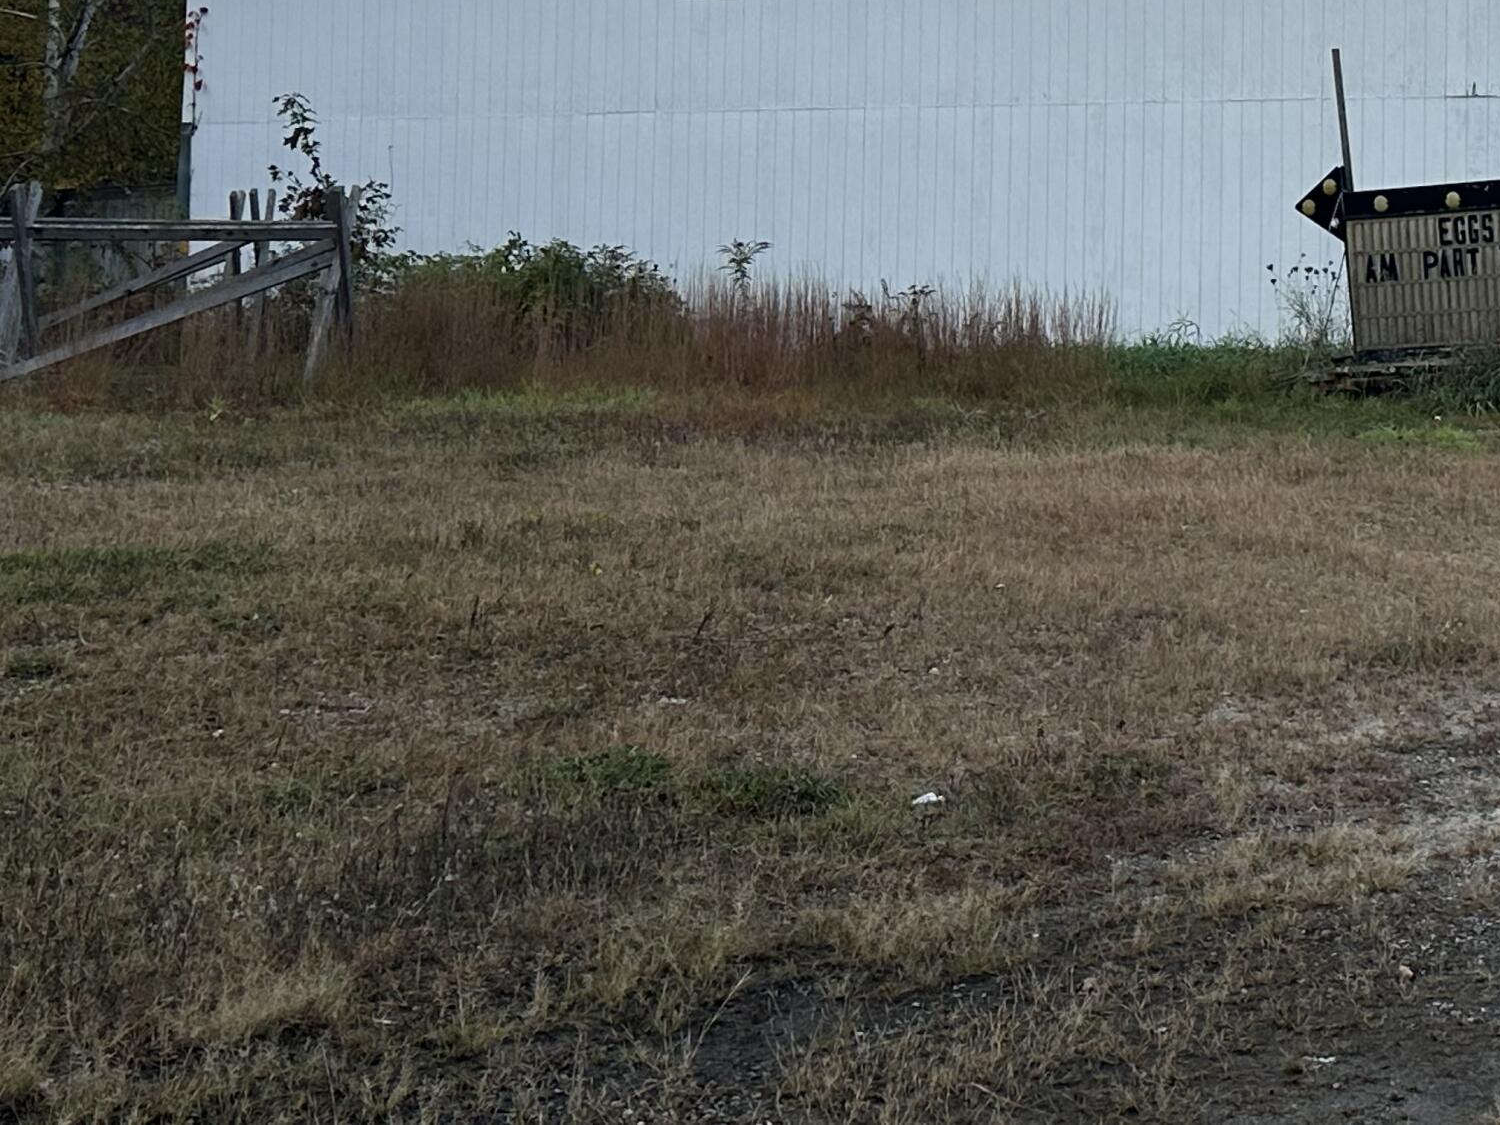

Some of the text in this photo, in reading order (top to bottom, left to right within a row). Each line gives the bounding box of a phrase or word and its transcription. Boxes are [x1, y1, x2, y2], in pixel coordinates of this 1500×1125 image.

[1439, 214, 1494, 246] EGGS
[1366, 253, 1398, 283] AM
[1423, 248, 1479, 279] PART
